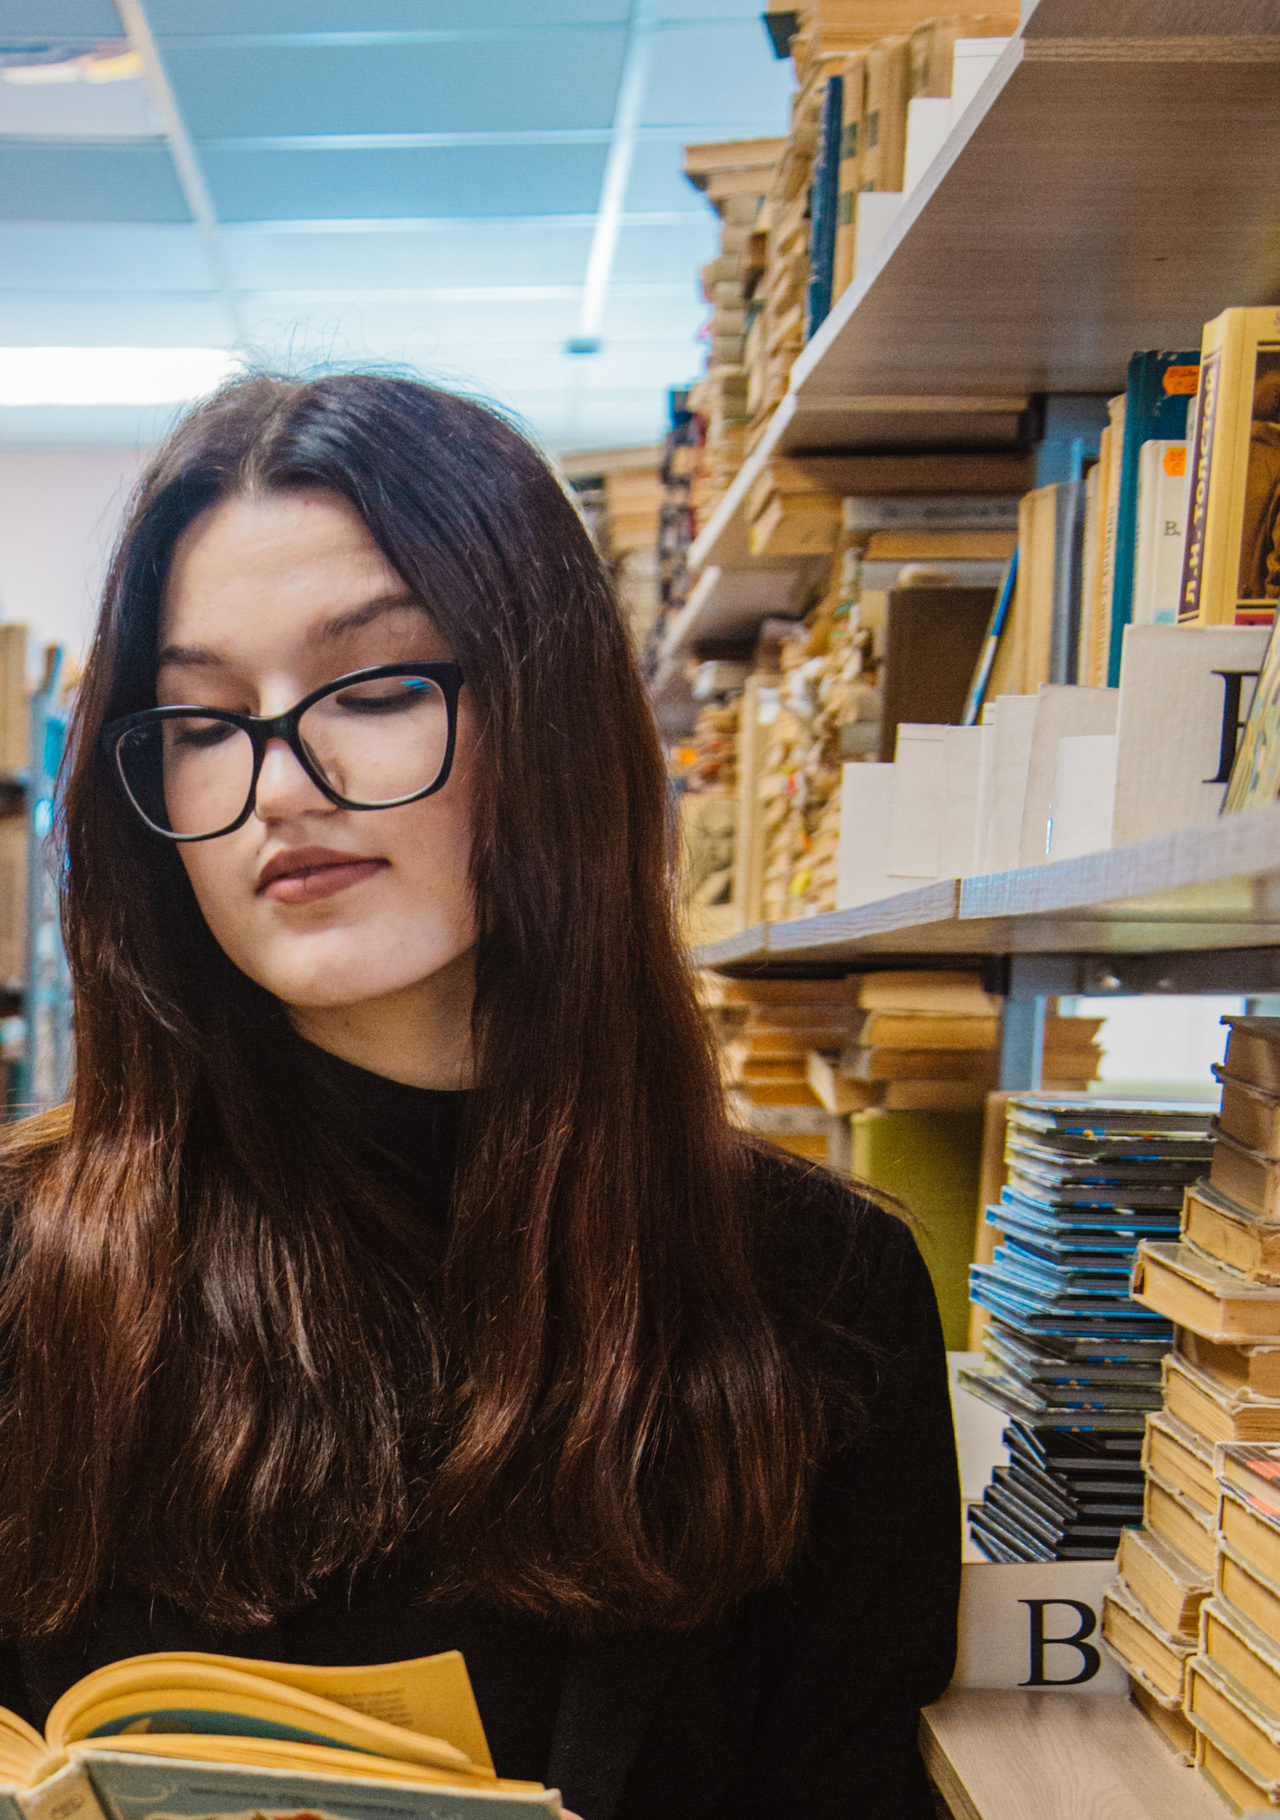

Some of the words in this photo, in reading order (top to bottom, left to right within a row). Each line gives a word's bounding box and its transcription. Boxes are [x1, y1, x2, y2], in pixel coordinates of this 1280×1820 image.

[1189, 363, 1218, 525] ТОЛСТОЙ
[1183, 529, 1202, 603] Л.Н.
[1017, 1598, 1102, 1688] В
